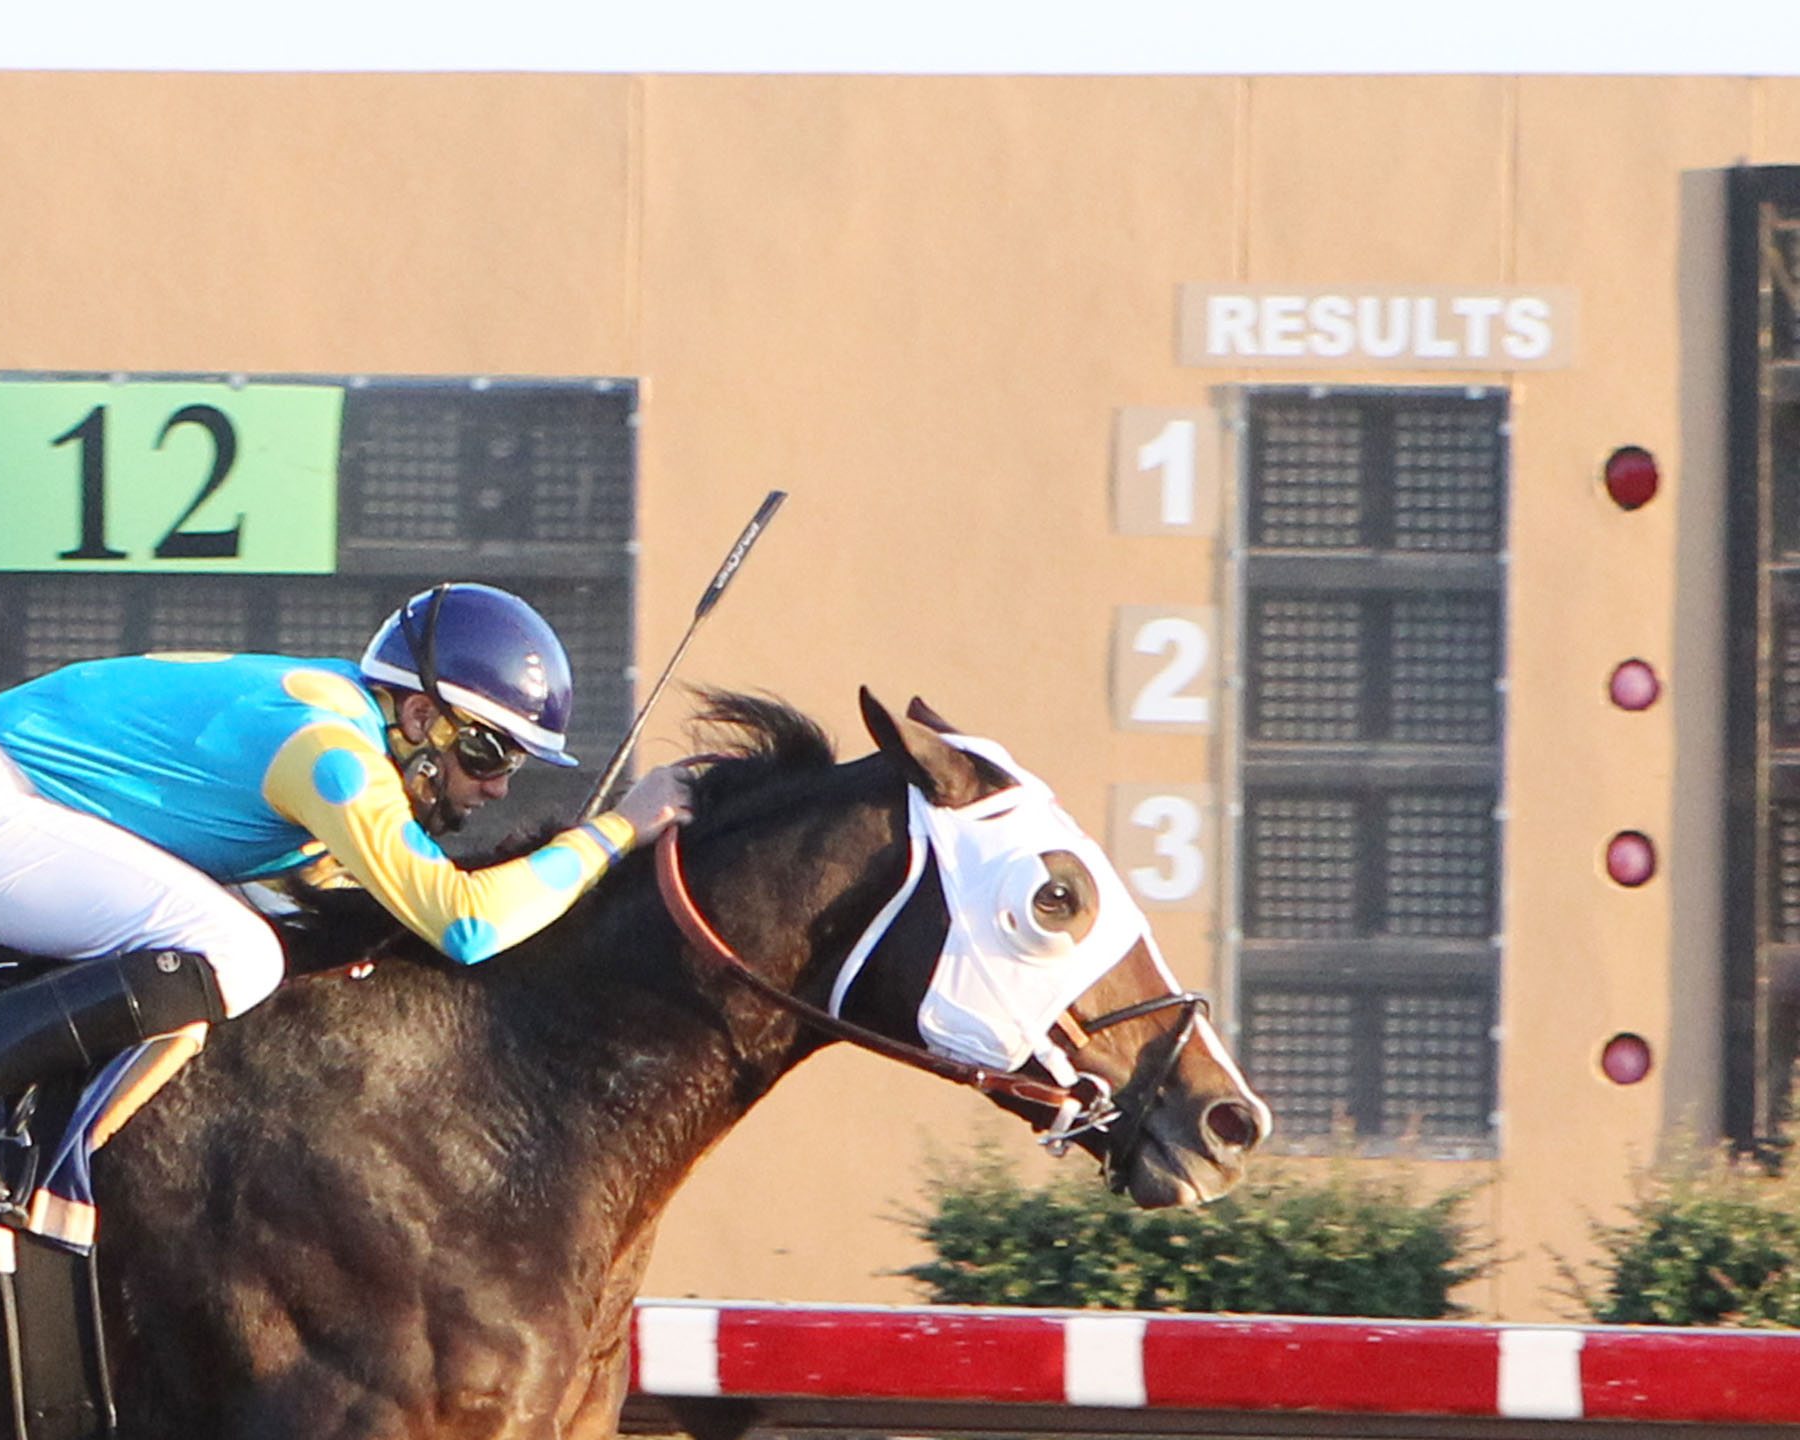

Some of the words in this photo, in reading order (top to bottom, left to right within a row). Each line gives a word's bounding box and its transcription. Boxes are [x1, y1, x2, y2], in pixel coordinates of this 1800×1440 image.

[1205, 296, 1552, 360] RESULTS
[50, 403, 247, 561] 12
[1136, 420, 1198, 526] 1
[1130, 618, 1210, 722] 2
[1128, 795, 1204, 902] 3
